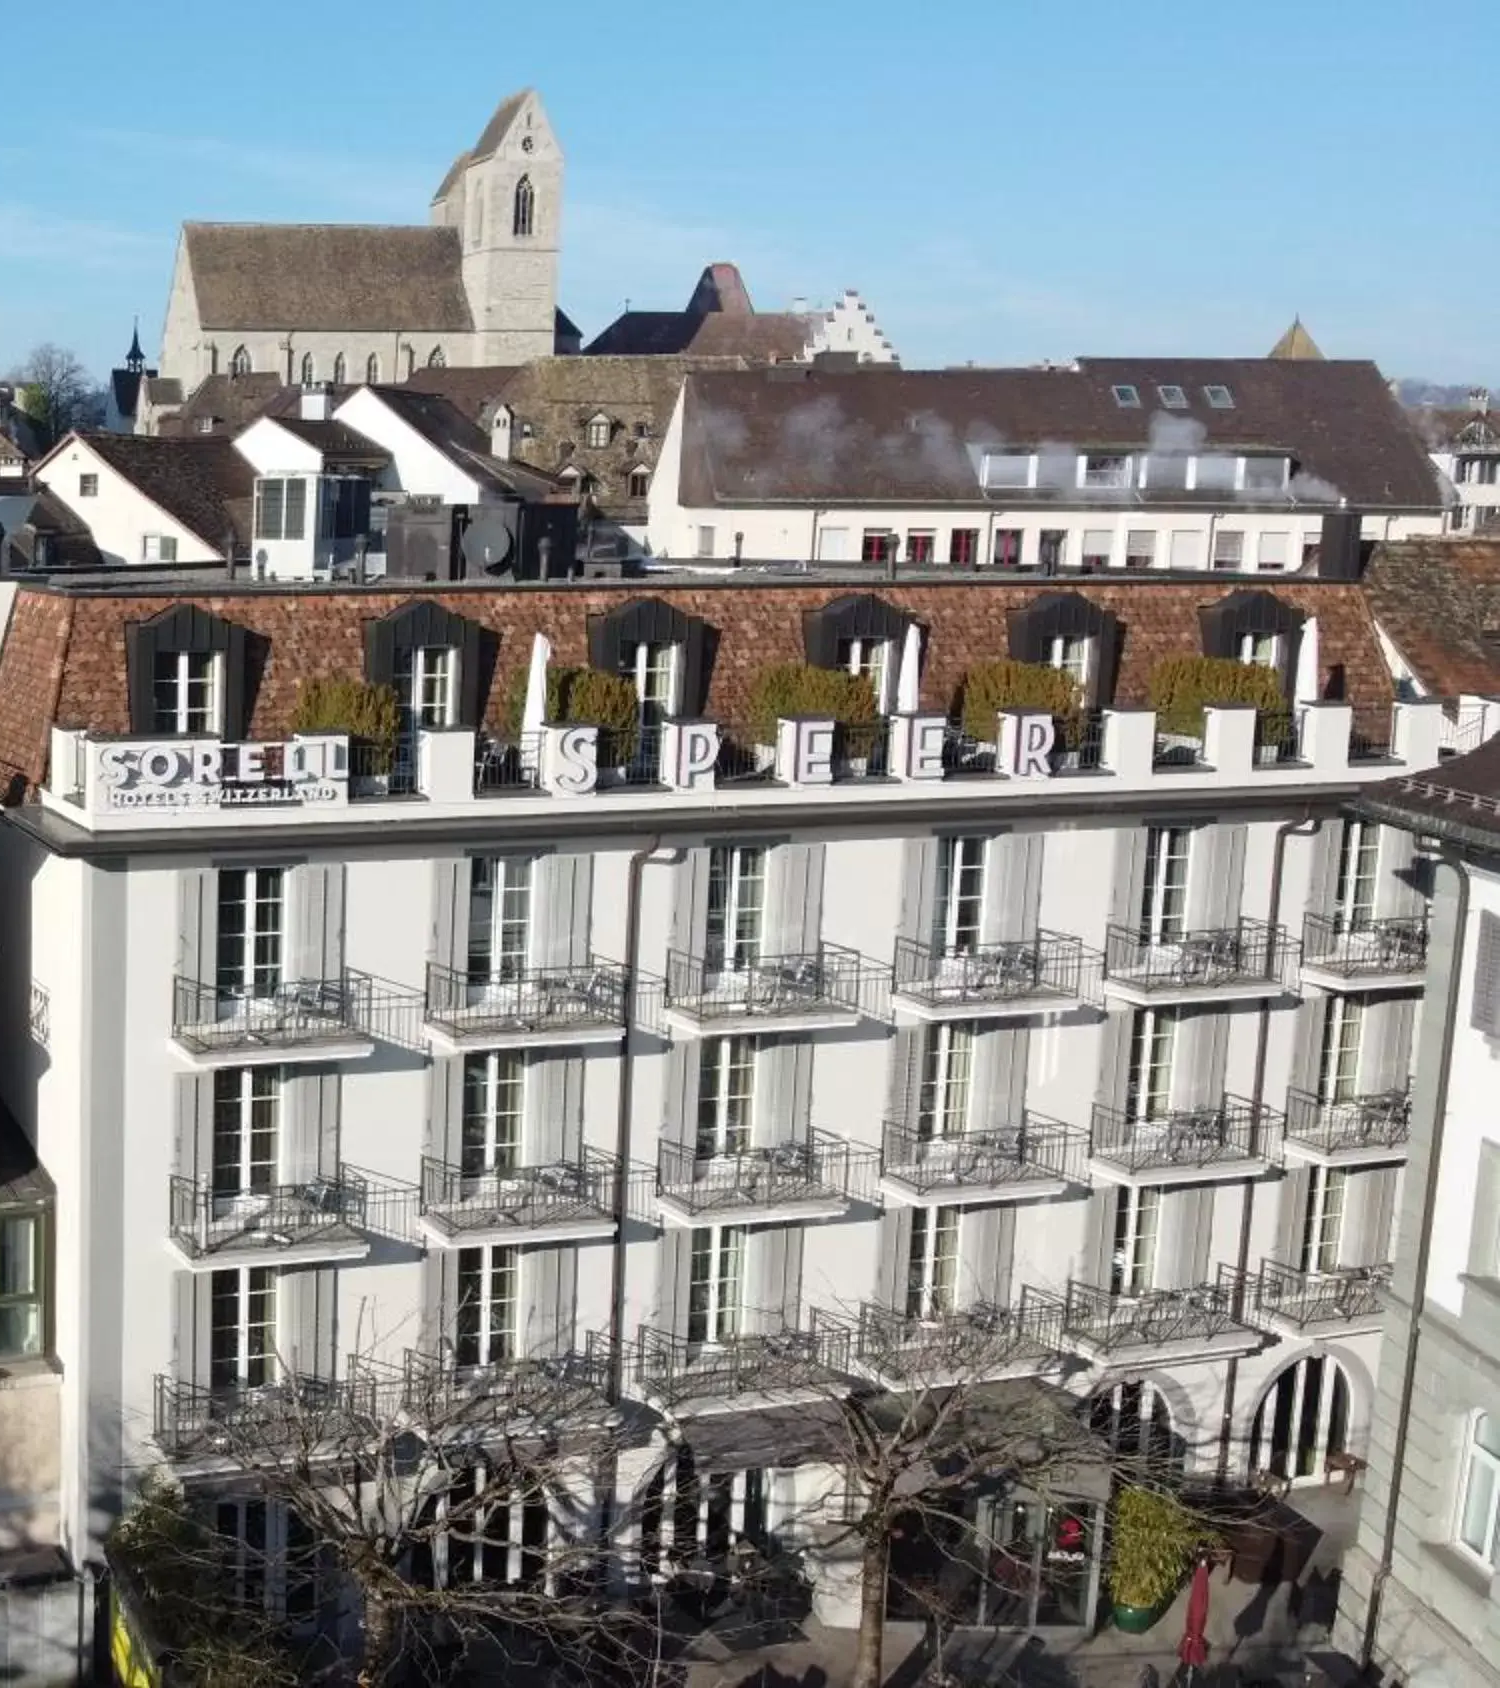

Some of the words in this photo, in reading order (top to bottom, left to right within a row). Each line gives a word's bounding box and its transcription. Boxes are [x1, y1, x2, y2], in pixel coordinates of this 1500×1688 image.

[99, 742, 349, 787] SORELL
[554, 713, 1055, 795] SPEER
[200, 784, 337, 806] SWITZERLAND
